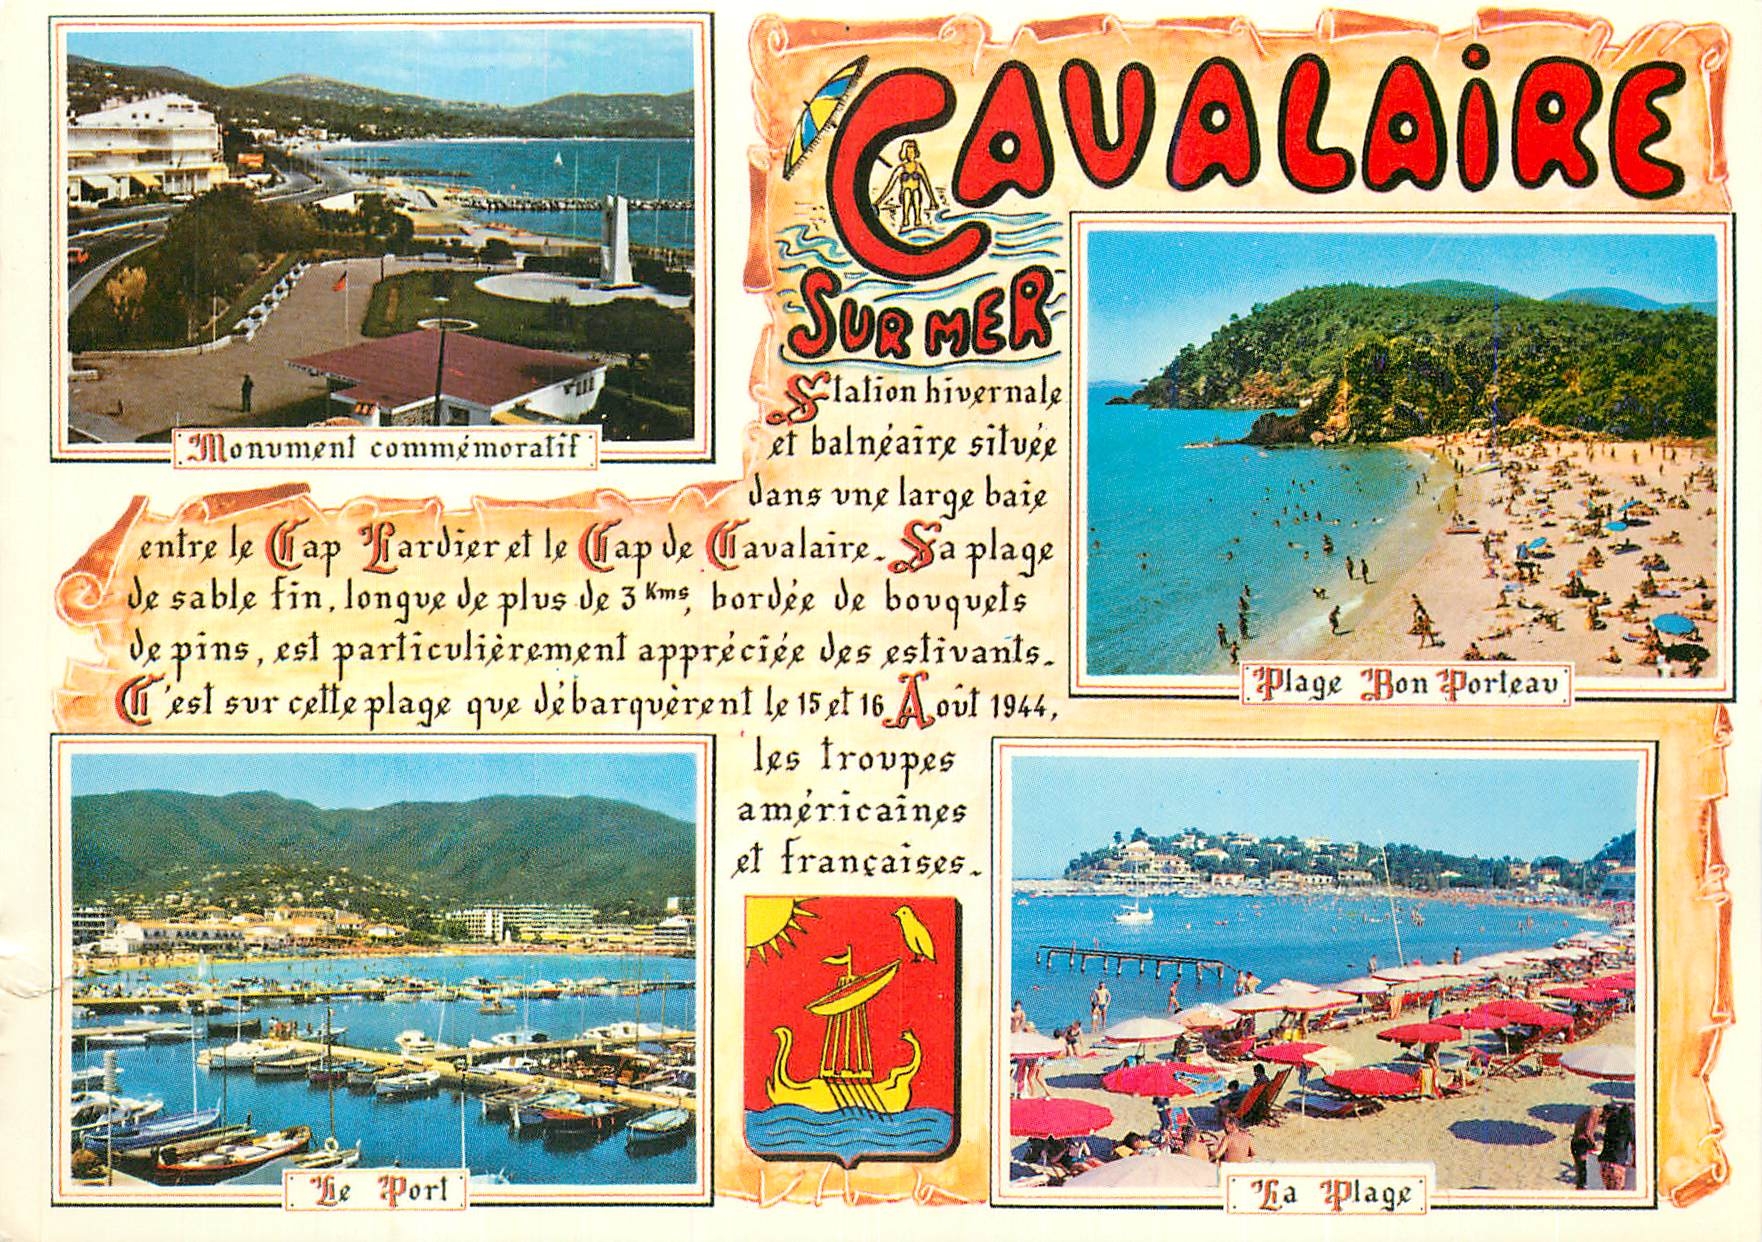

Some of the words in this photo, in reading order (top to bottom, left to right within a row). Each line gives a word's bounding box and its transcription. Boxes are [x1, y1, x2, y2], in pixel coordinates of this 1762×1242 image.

[788, 267, 913, 358] SUR
[925, 264, 1054, 357] MER
[766, 371, 917, 425] Station
[926, 374, 1062, 410] hivernale
[187, 433, 357, 462] Monument
[369, 432, 581, 462] commémoratif
[768, 429, 798, 459] et
[812, 423, 957, 461] balnéaire
[968, 423, 1057, 461] située
[749, 473, 823, 506] dans
[831, 488, 889, 511] une
[899, 475, 975, 520] large
[986, 474, 1048, 513] baie
[138, 527, 218, 562] entre
[230, 523, 253, 562] le
[266, 518, 341, 577] Cap
[505, 528, 535, 564] et
[545, 527, 568, 564] le
[578, 519, 652, 578] Cap
[662, 523, 694, 563] de
[887, 520, 955, 573] Sa
[965, 528, 1054, 577] plage
[127, 576, 159, 613] de
[170, 577, 257, 614] sable
[271, 576, 335, 614] fin,
[345, 578, 446, 624] longue
[457, 577, 488, 616] de
[498, 577, 567, 627] plus
[579, 579, 610, 616] de
[621, 586, 637, 611] 3
[712, 578, 816, 617] bordée
[834, 579, 865, 616] de
[885, 578, 1027, 630] bouquets
[130, 628, 161, 666] de
[273, 630, 320, 665] est
[333, 629, 628, 681] particulièrement
[638, 630, 806, 680] appréciée
[819, 630, 871, 669] des
[224, 695, 280, 715] sur
[288, 682, 357, 719] cette
[364, 680, 451, 730] plage
[466, 695, 520, 731] que
[534, 679, 752, 730] débarquèrent
[764, 684, 787, 722] le
[799, 694, 821, 716] 15
[824, 685, 855, 721] et
[861, 694, 884, 717] 16
[882, 670, 982, 730] Août
[991, 693, 1058, 721] 1944,
[1252, 667, 1343, 702] Plage
[1360, 667, 1429, 702] Bon
[1435, 667, 1558, 702] Porteau
[754, 736, 800, 775] les
[821, 736, 956, 790] troupes
[737, 788, 967, 829] américaines
[731, 842, 763, 879] et
[310, 1174, 351, 1207] Le
[378, 1175, 448, 1207] Port
[1251, 1179, 1298, 1211] La
[1320, 1179, 1411, 1212] Plage
